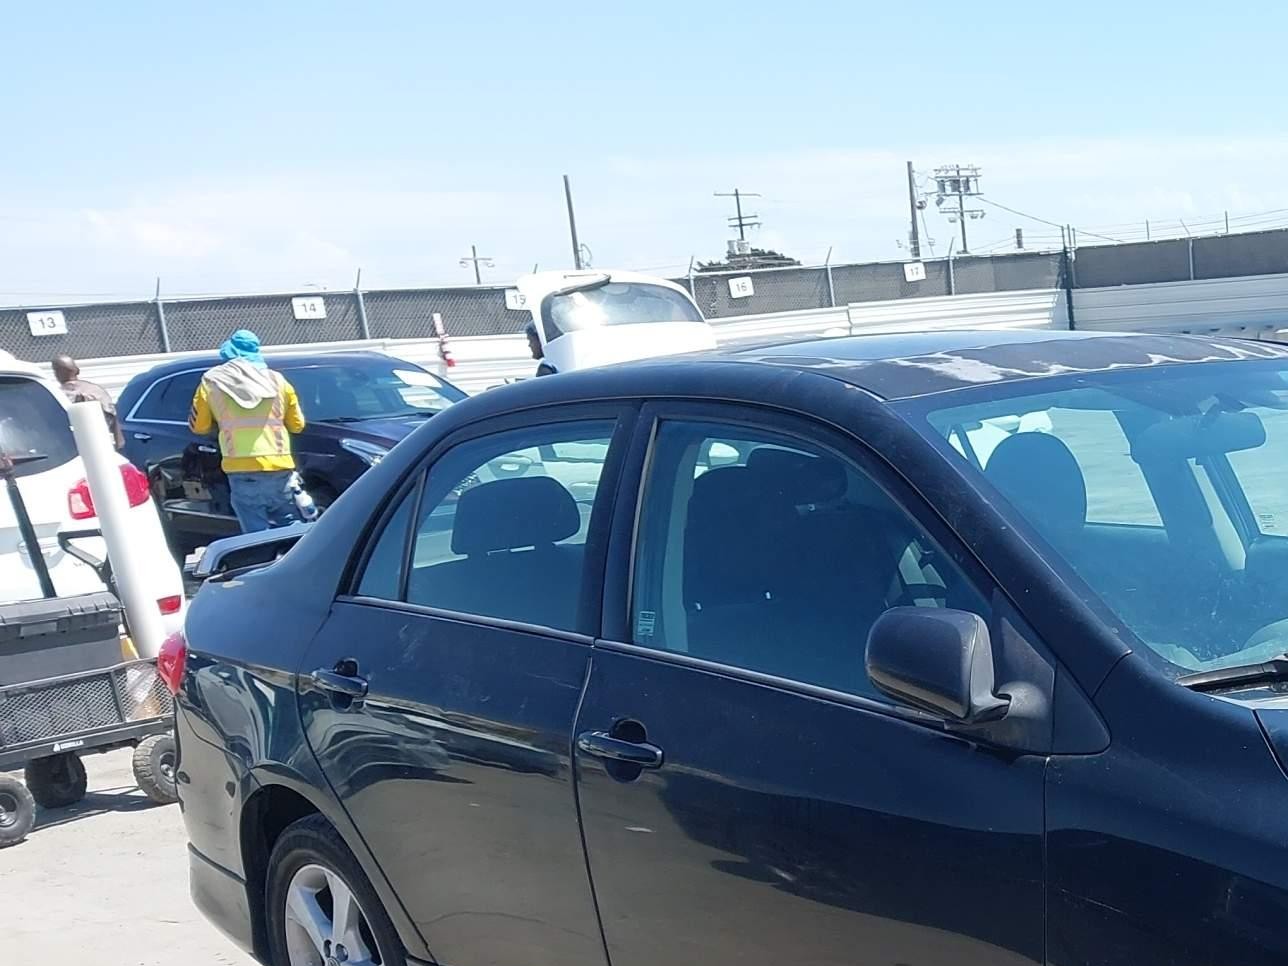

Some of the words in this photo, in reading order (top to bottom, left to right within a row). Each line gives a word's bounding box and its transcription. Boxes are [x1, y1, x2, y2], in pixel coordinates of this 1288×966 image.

[736, 281, 748, 292] 16
[512, 294, 527, 304] 15
[302, 303, 317, 312] 14
[38, 316, 57, 329] 13
